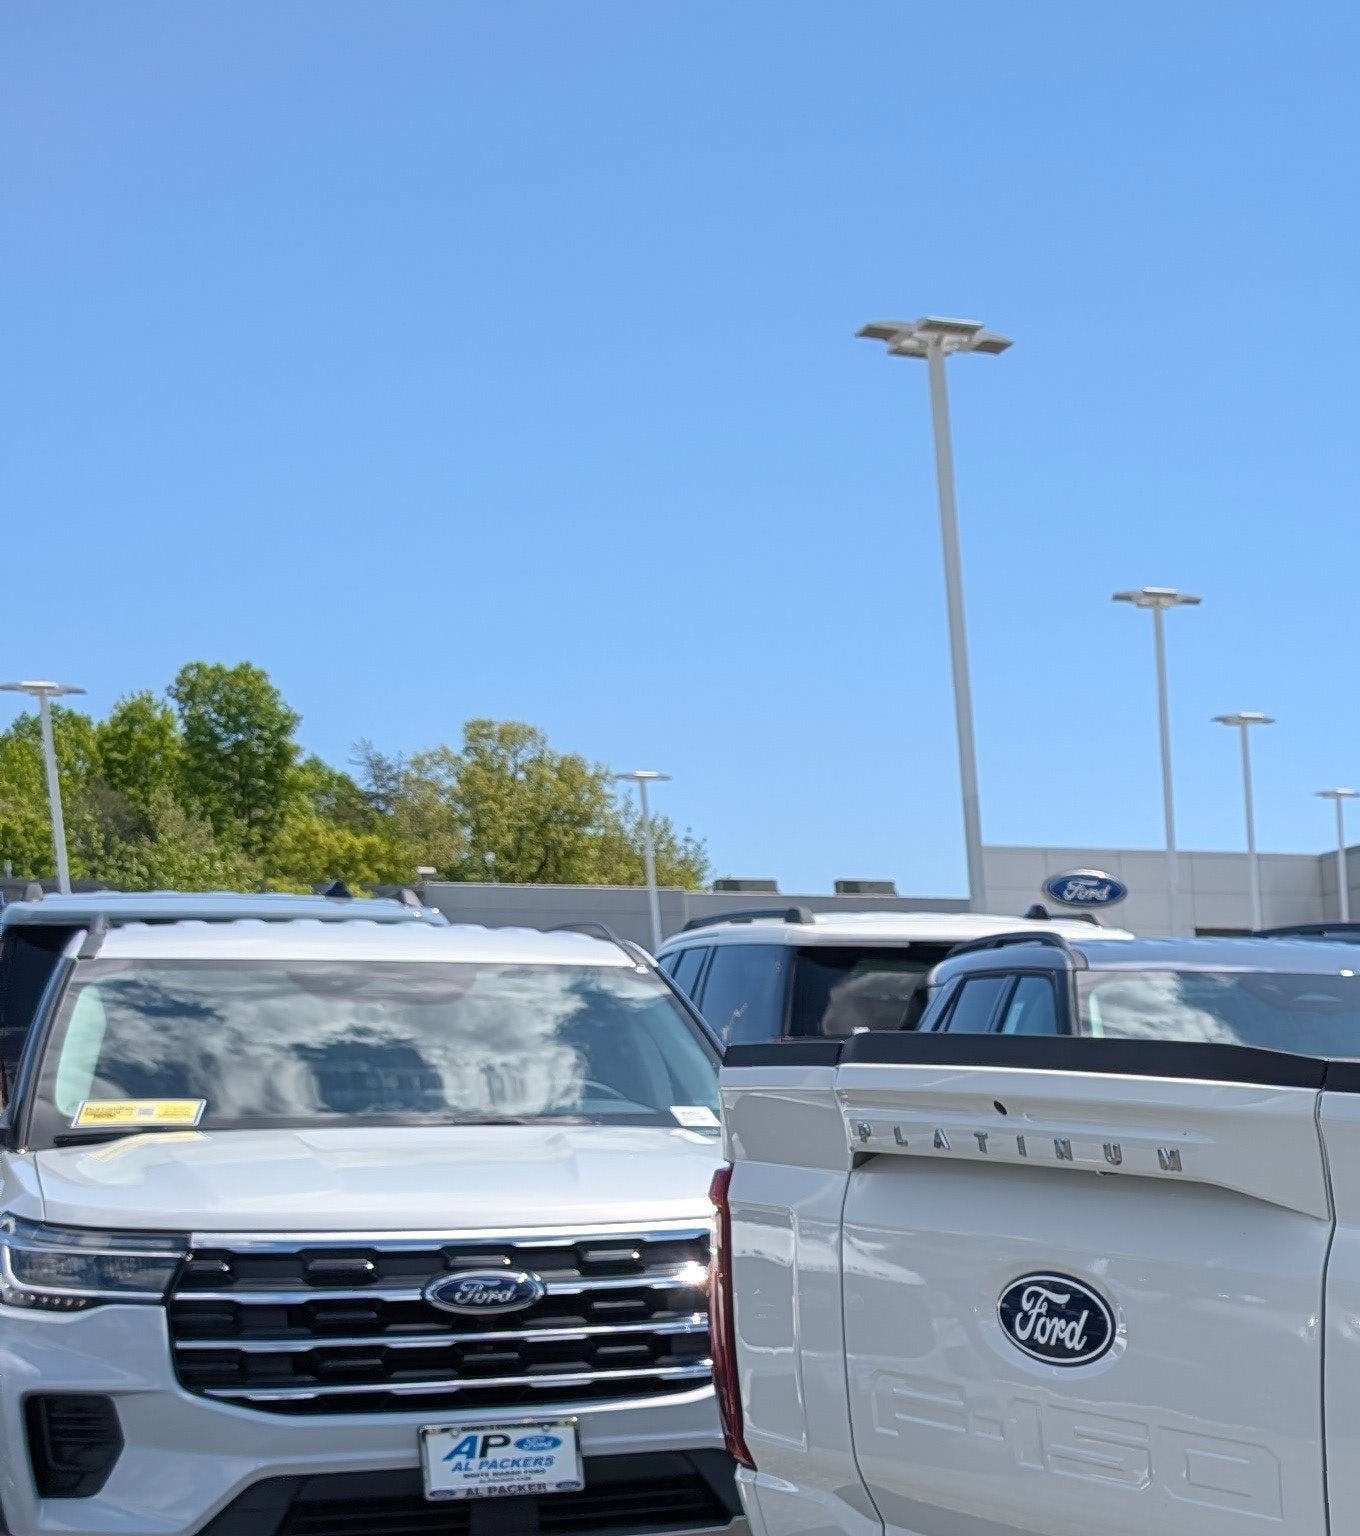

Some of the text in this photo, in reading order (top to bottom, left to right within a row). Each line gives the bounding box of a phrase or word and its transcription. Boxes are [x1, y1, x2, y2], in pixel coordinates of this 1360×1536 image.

[1063, 879, 1111, 901] Ford
[857, 1120, 1183, 1172] PLATINUM
[454, 1279, 517, 1304] Ford
[1015, 1285, 1089, 1351] Ford
[442, 1433, 511, 1461] AP
[869, 1367, 1285, 1522] F-150
[452, 1455, 555, 1472] AL PACKERS
